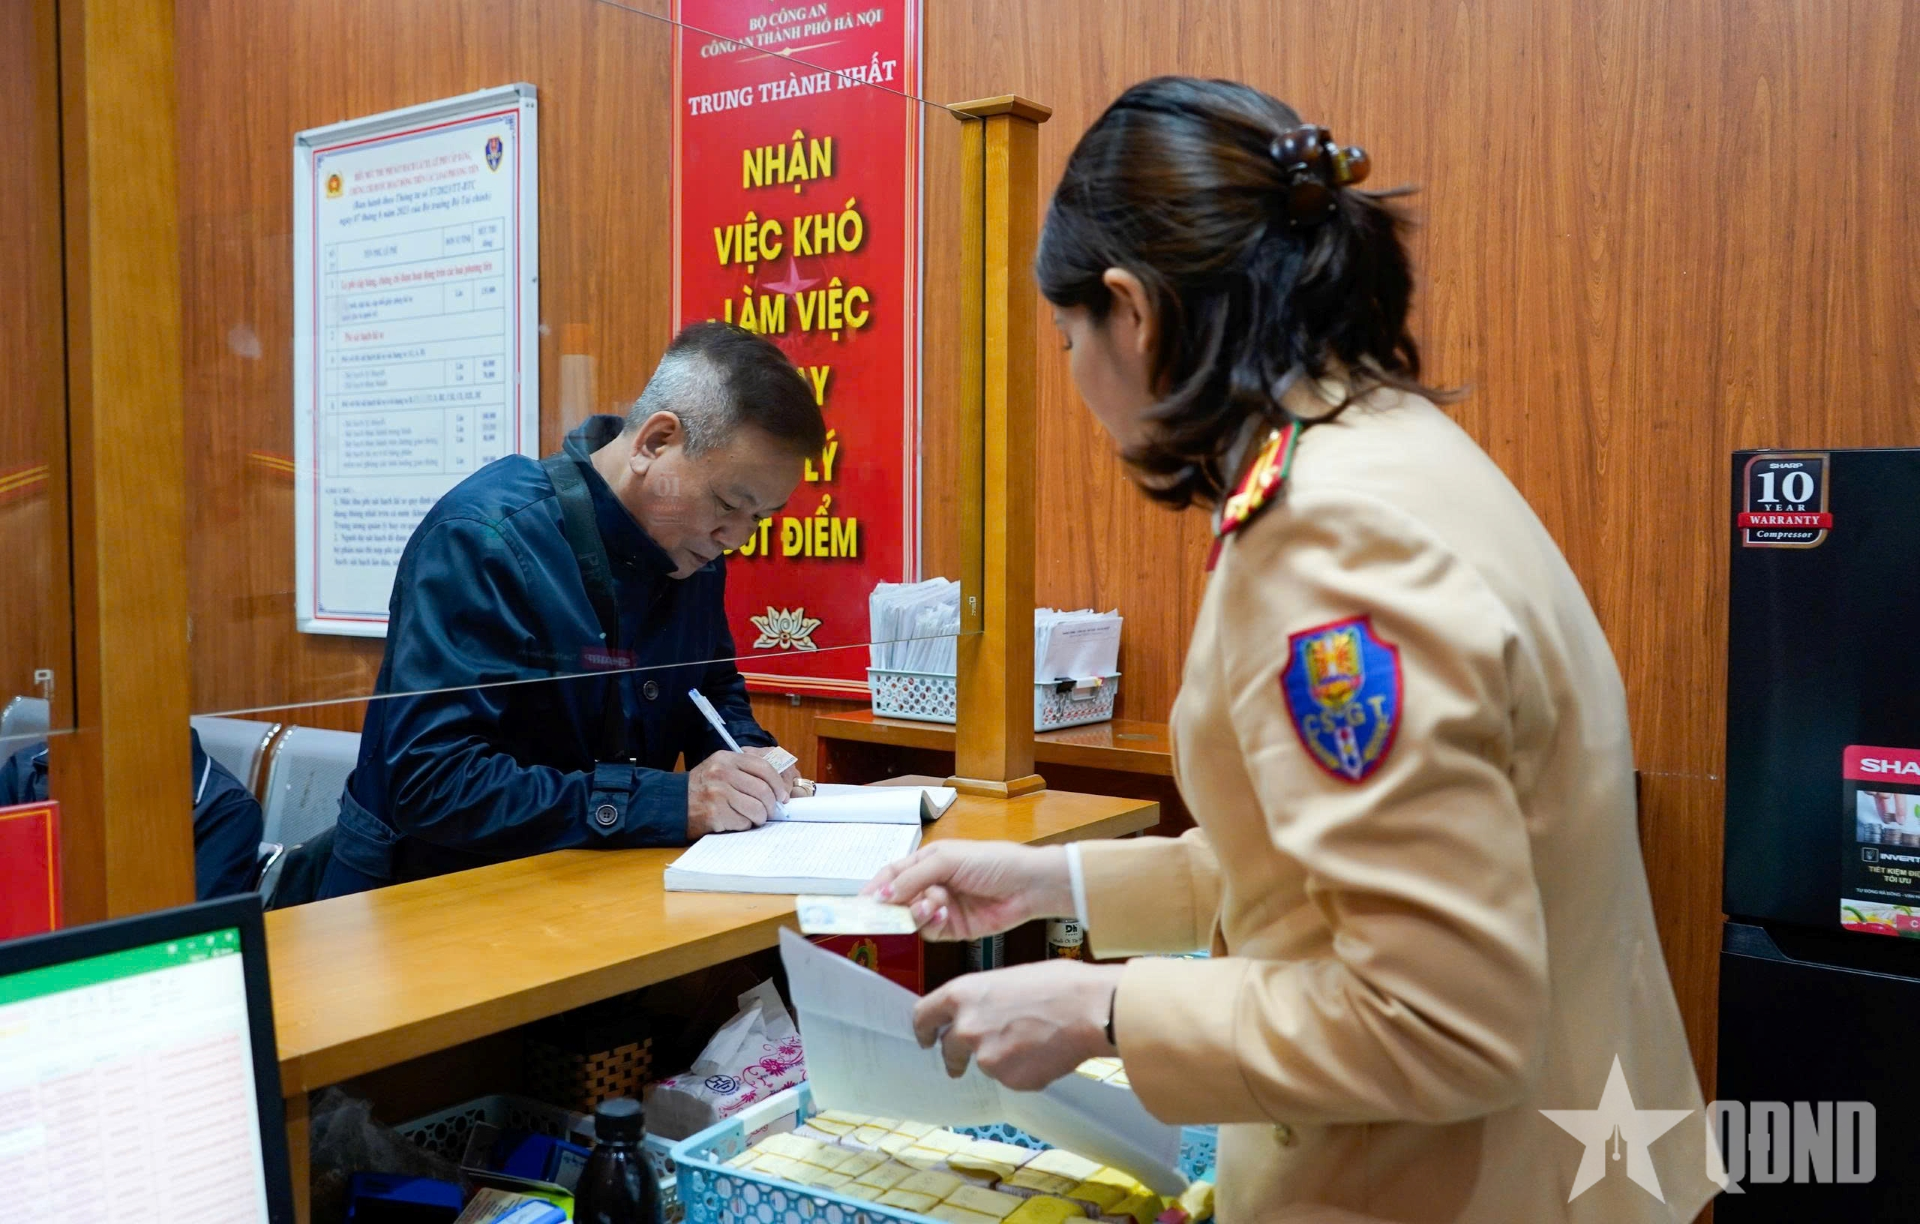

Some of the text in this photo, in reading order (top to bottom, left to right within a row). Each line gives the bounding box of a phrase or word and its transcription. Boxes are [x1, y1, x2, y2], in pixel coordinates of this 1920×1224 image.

[700, 40, 736, 58] CÔNG
[738, 36, 753, 50] AN
[756, 26, 801, 47] THÀNH
[834, 12, 854, 31] HÀ
[856, 9, 884, 27] NỘI
[749, 3, 828, 32] BỘ CÔNG AN
[688, 51, 897, 116] TRUNG THÀNH NHẤT
[743, 129, 832, 194] NHẬN
[713, 197, 863, 274] VIỆC KHÓ
[724, 277, 870, 341] LÀM VIỆC
[1757, 471, 1815, 503] 10
[1764, 504, 1806, 512] YEAR
[780, 494, 857, 558] ĐIỂM
[1749, 516, 1820, 525] WARRANTY
[1756, 530, 1813, 540] Compressor
